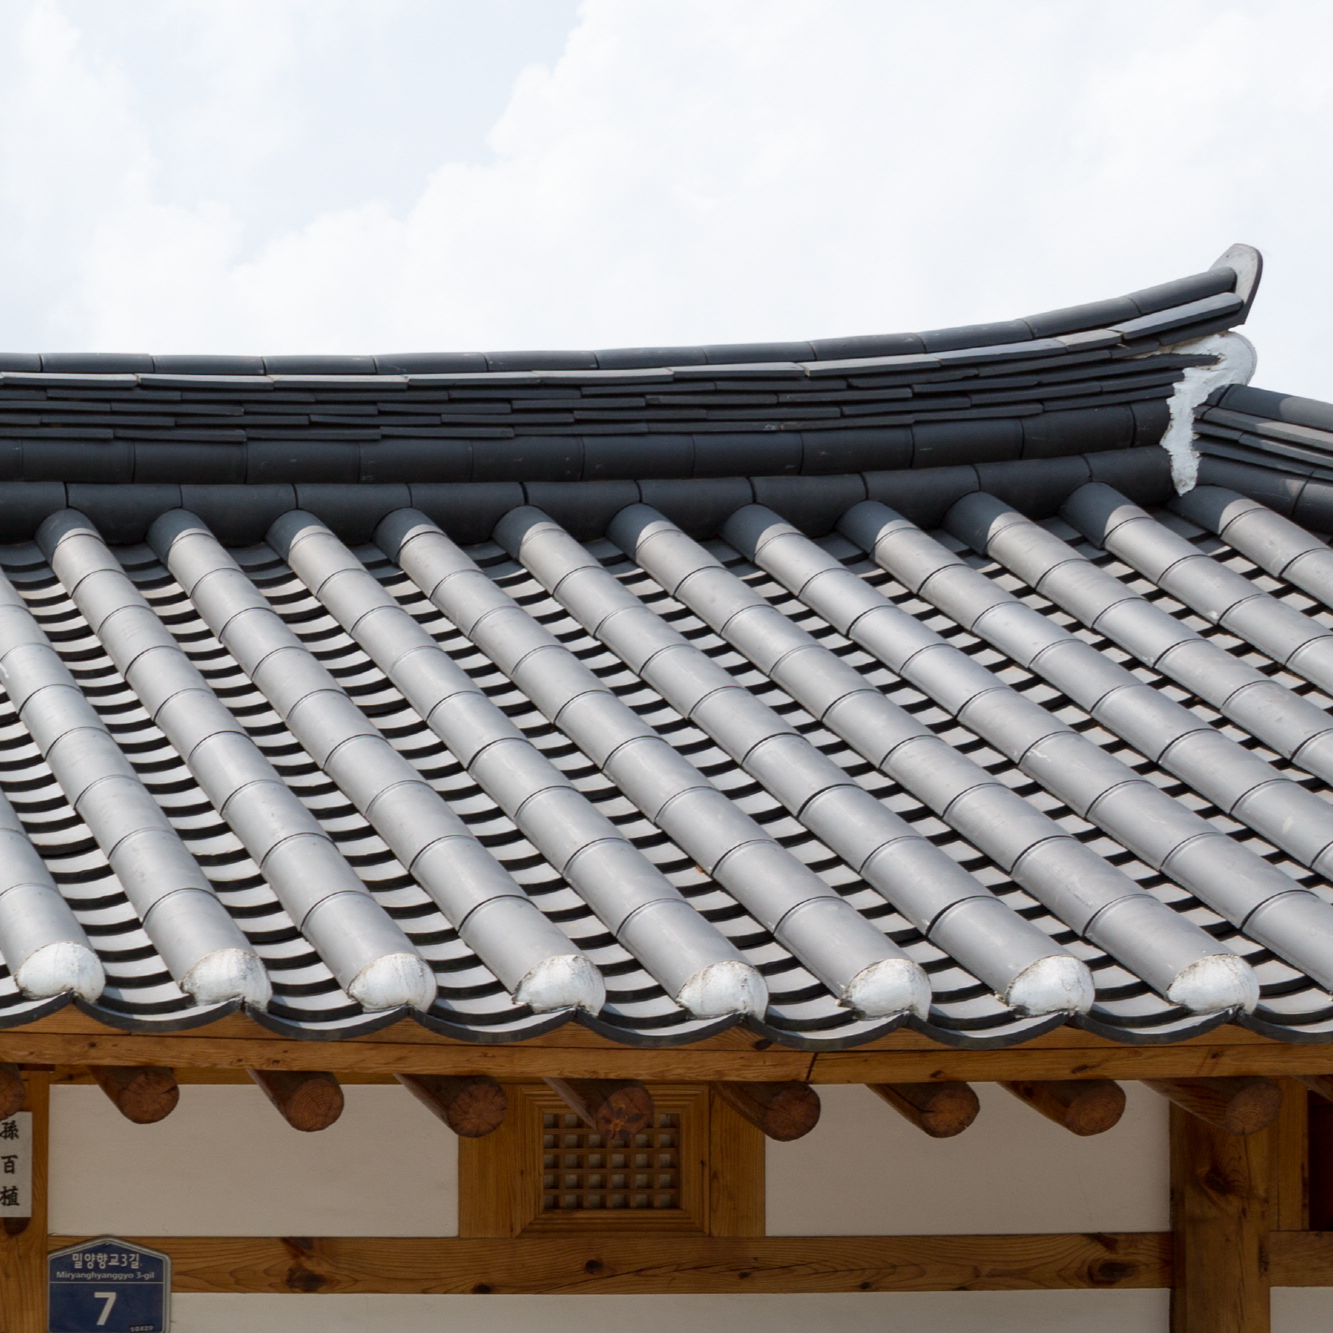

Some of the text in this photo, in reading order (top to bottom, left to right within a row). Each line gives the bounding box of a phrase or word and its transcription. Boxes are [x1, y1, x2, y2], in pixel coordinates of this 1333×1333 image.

[72, 1253, 140, 1269] 밀양향교3길
[56, 1271, 155, 1280] Miryanghyanggyo 3-gil
[94, 1291, 116, 1326] 7
